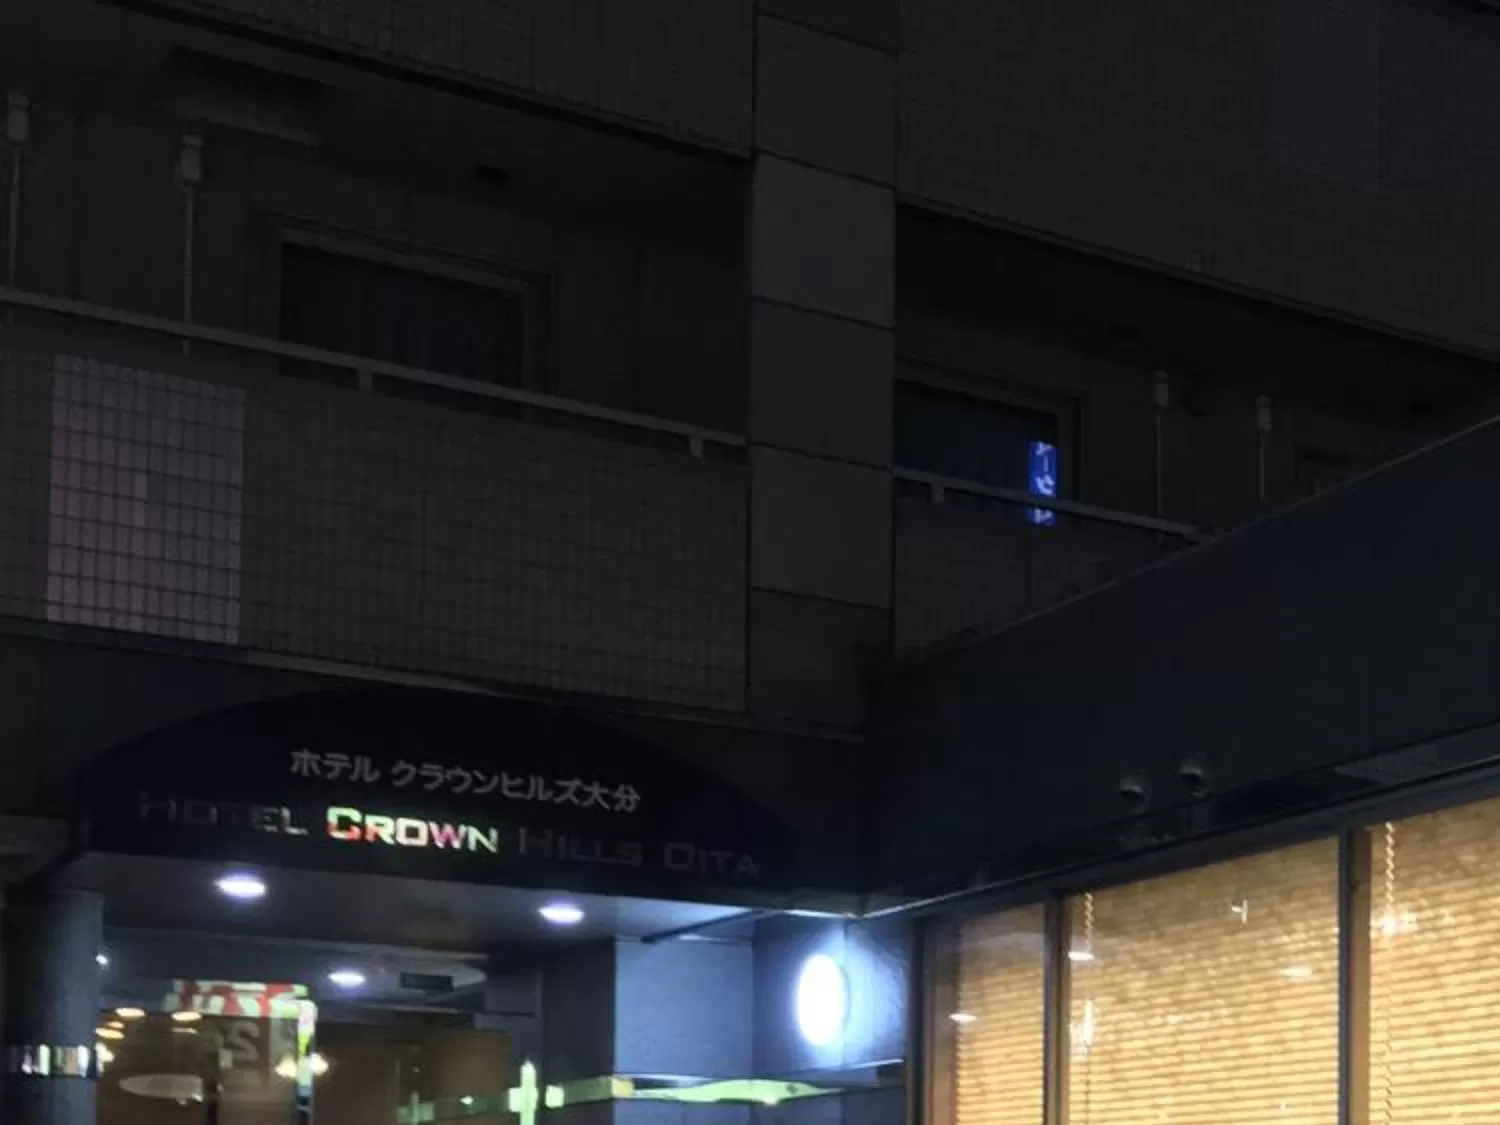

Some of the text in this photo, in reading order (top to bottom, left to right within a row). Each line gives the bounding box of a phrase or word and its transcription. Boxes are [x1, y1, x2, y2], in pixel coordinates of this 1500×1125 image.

[288, 747, 642, 815] ホテル クラウンヒルズ大分
[325, 804, 499, 853] CROWN
